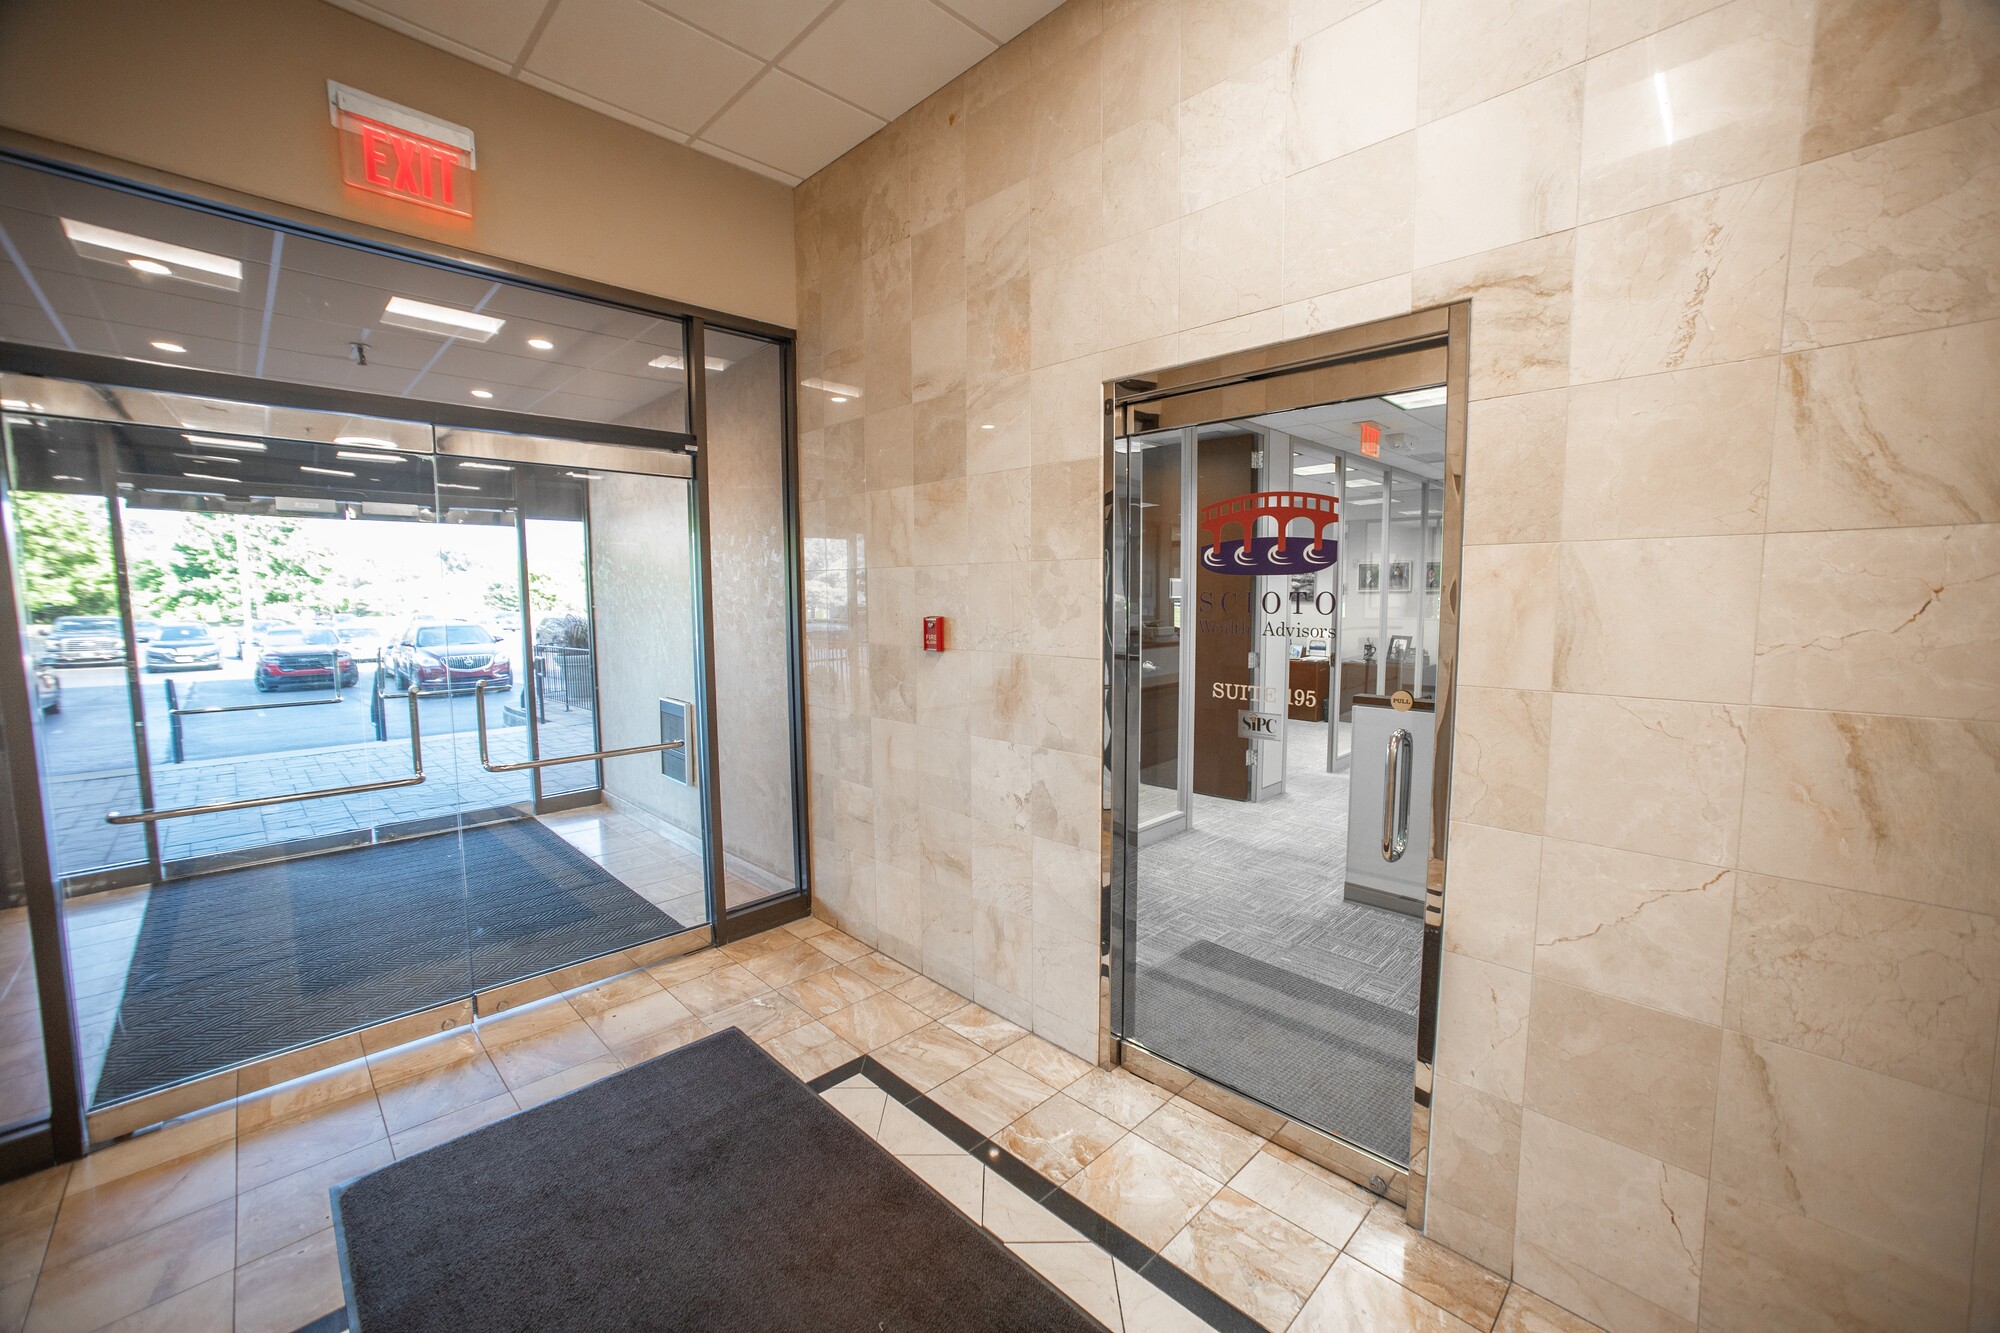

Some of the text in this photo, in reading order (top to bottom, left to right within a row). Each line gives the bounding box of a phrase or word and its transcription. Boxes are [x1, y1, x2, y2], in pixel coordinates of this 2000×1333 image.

[362, 124, 459, 206] EXIT
[1200, 591, 1336, 615] SCIOTO
[1262, 621, 1336, 638] Advisors
[1212, 682, 1317, 708] SUITE 195
